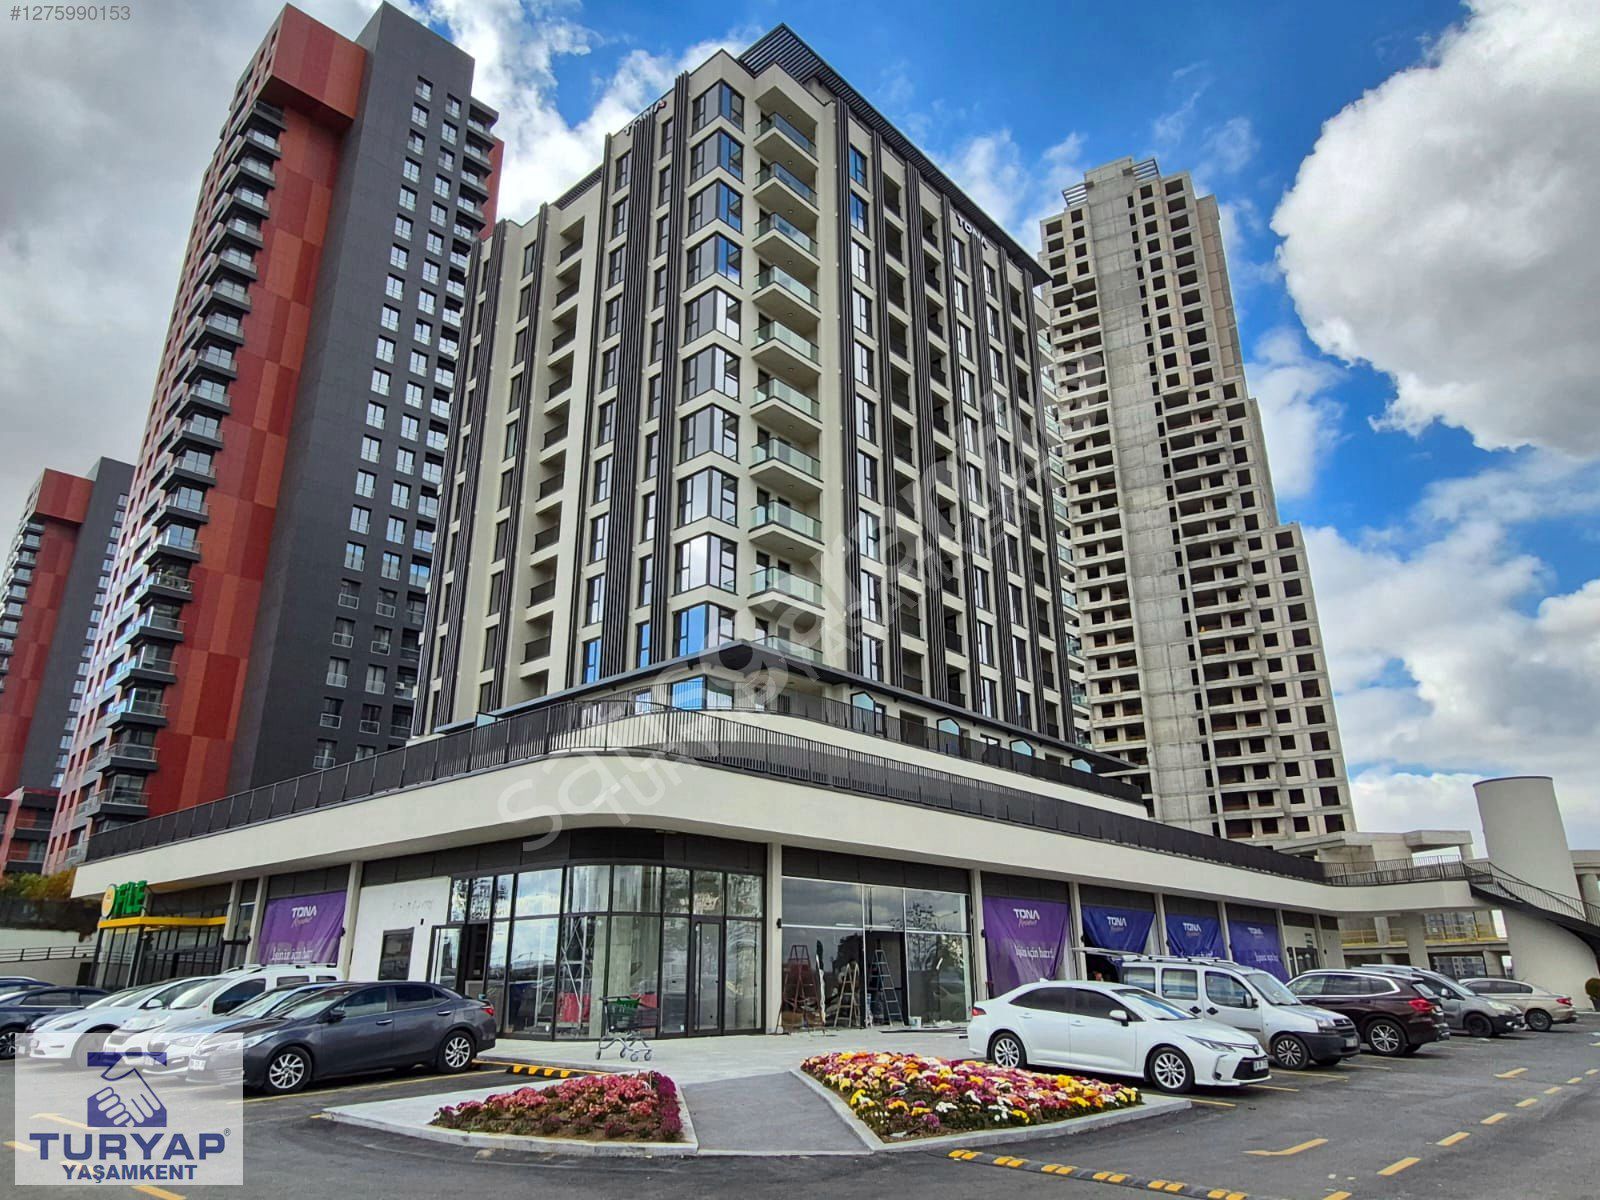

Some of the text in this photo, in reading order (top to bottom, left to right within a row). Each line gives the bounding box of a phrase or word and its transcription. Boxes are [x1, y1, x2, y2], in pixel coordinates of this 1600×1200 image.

[291, 905, 318, 918] TONA
[1013, 908, 1041, 920] TONA
[1106, 916, 1128, 927] TONA
